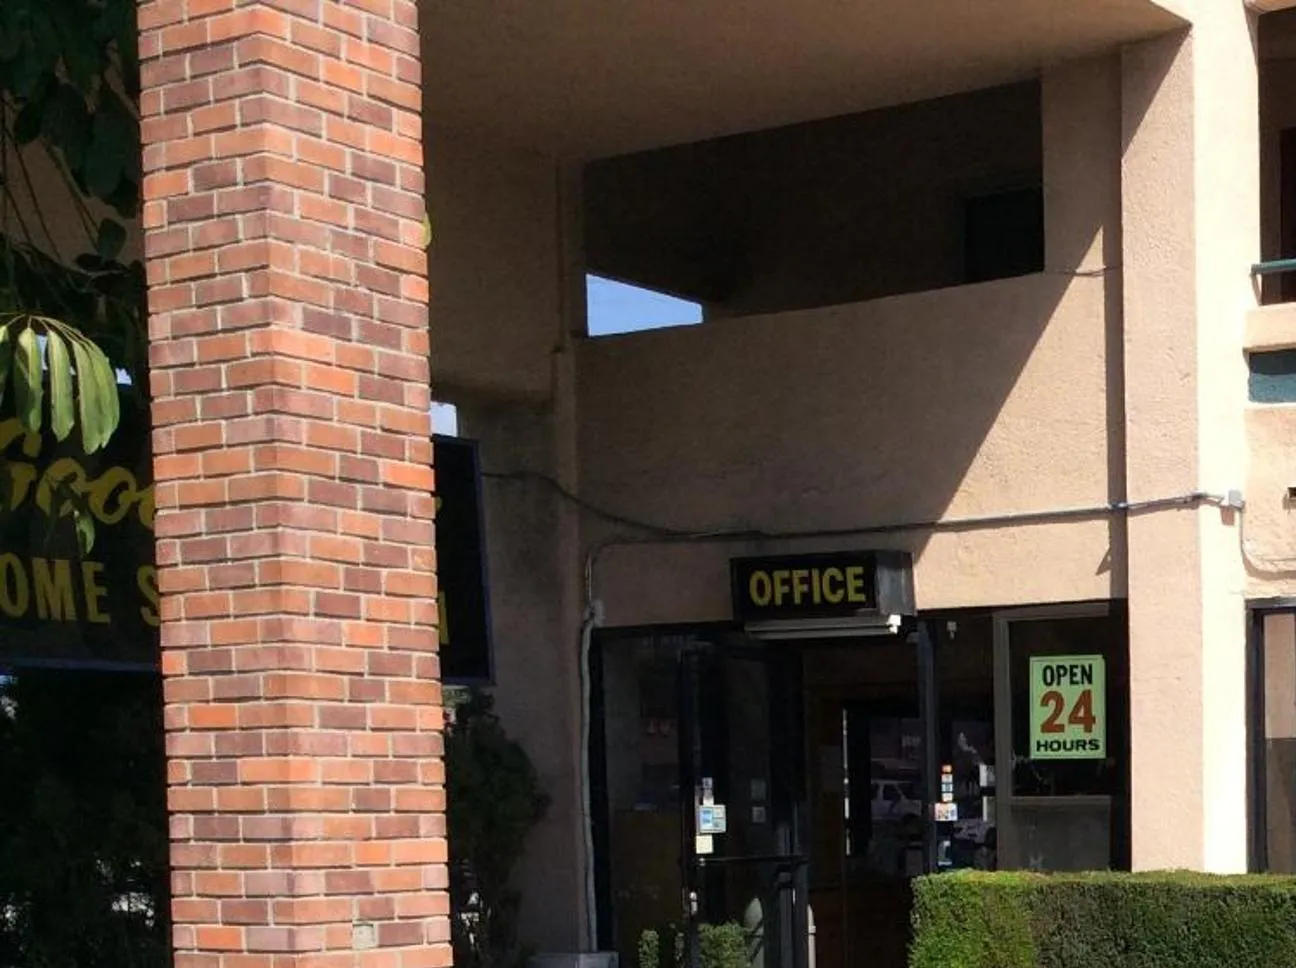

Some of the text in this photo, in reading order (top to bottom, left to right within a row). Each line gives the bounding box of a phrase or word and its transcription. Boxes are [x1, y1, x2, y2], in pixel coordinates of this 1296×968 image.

[750, 566, 866, 606] OFFICE
[1042, 664, 1093, 686] OPEN
[1040, 689, 1096, 733] 24
[1036, 738, 1100, 752] HOURS
